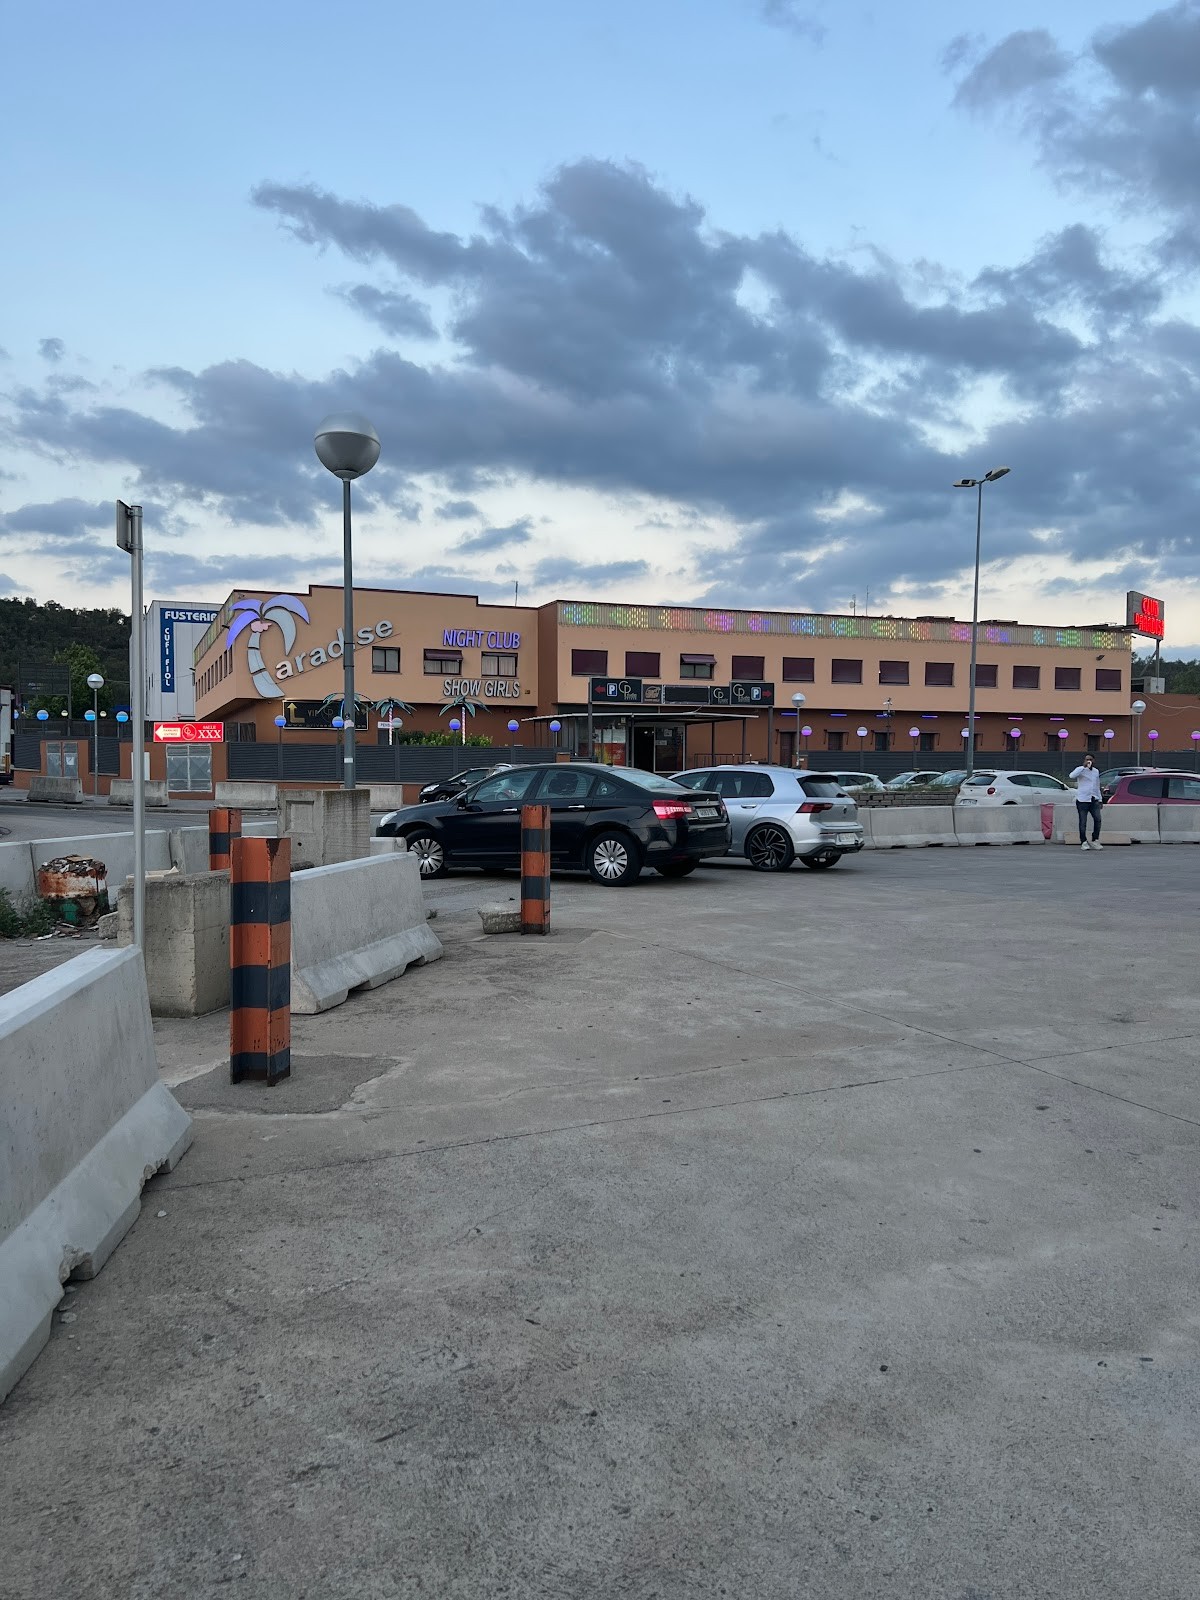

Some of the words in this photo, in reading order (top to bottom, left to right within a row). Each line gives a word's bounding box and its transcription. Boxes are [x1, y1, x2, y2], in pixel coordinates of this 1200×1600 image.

[443, 629, 484, 647] NIGHT
[487, 631, 520, 649] CLUB
[443, 679, 482, 697] SHOW
[485, 680, 520, 698] GIRLS
[198, 730, 221, 739] XXX
